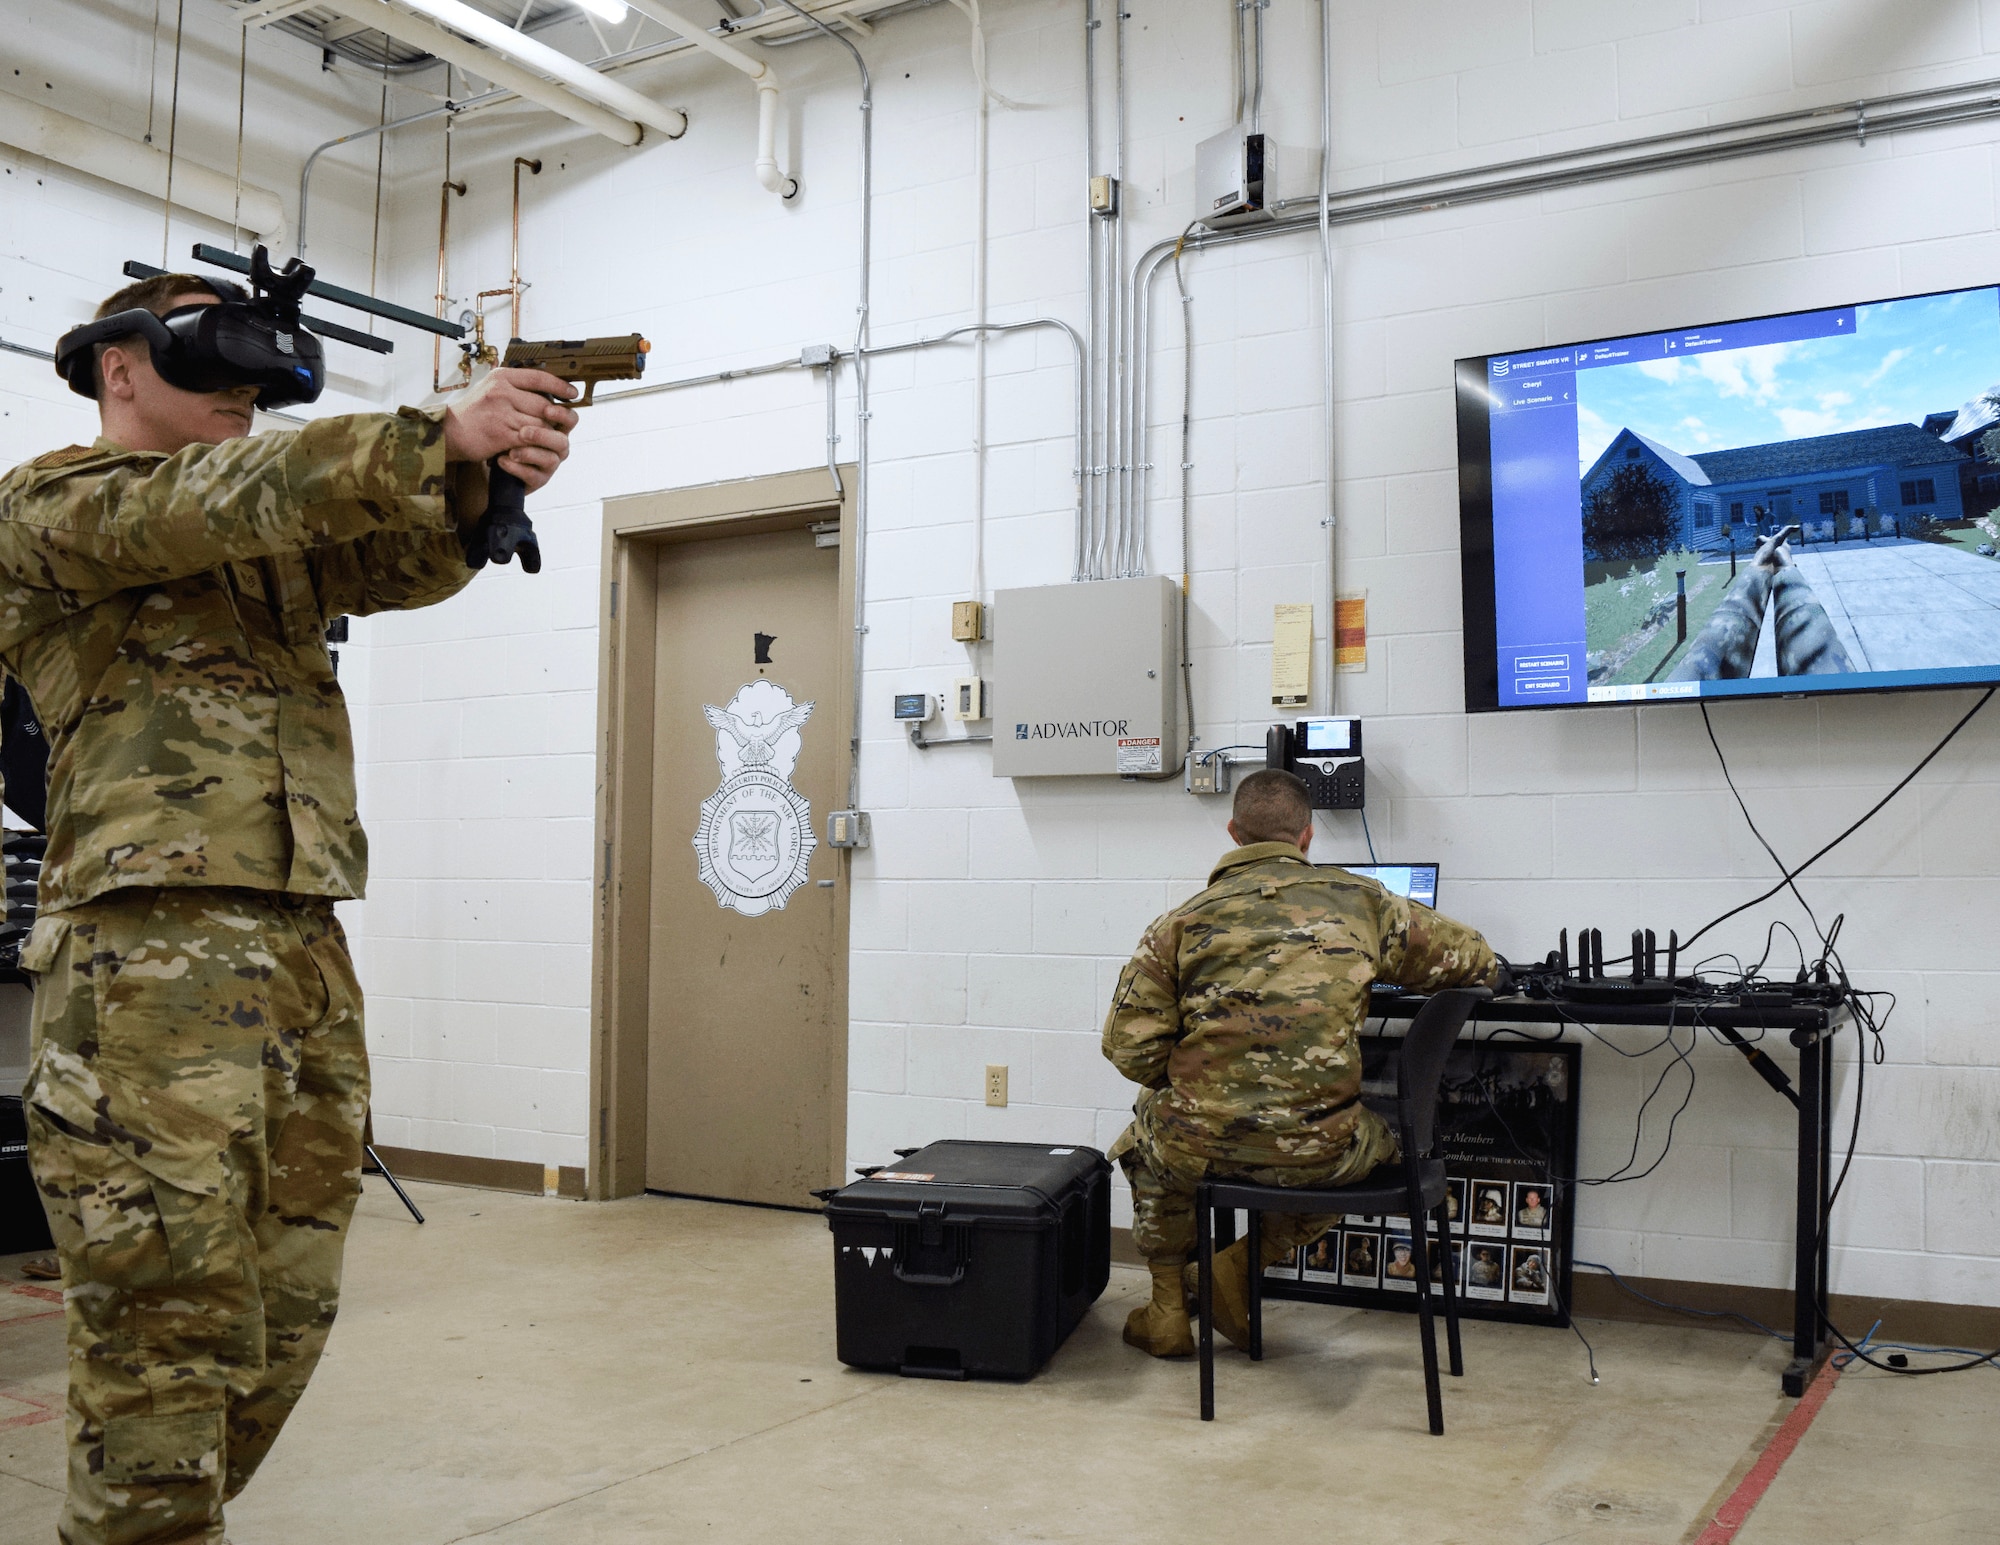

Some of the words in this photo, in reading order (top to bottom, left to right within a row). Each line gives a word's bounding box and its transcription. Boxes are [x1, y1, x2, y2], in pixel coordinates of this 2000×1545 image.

[1512, 360, 1535, 370] STREET
[1535, 358, 1560, 368] SMARTS
[1560, 356, 1570, 364] VR
[1512, 398, 1526, 406] Live
[1526, 394, 1553, 405] Scenario
[1031, 719, 1129, 739] ADVANTOR
[1127, 738, 1157, 746] DANGER
[727, 775, 758, 790] SECURITY
[760, 775, 785, 791] POLICE
[711, 795, 738, 859] DEPARTMENT
[741, 788, 755, 798] OF
[760, 788, 777, 803] THE
[779, 803, 793, 820] AIR
[787, 825, 798, 863] FORCE
[1453, 1132, 1495, 1145] Members
